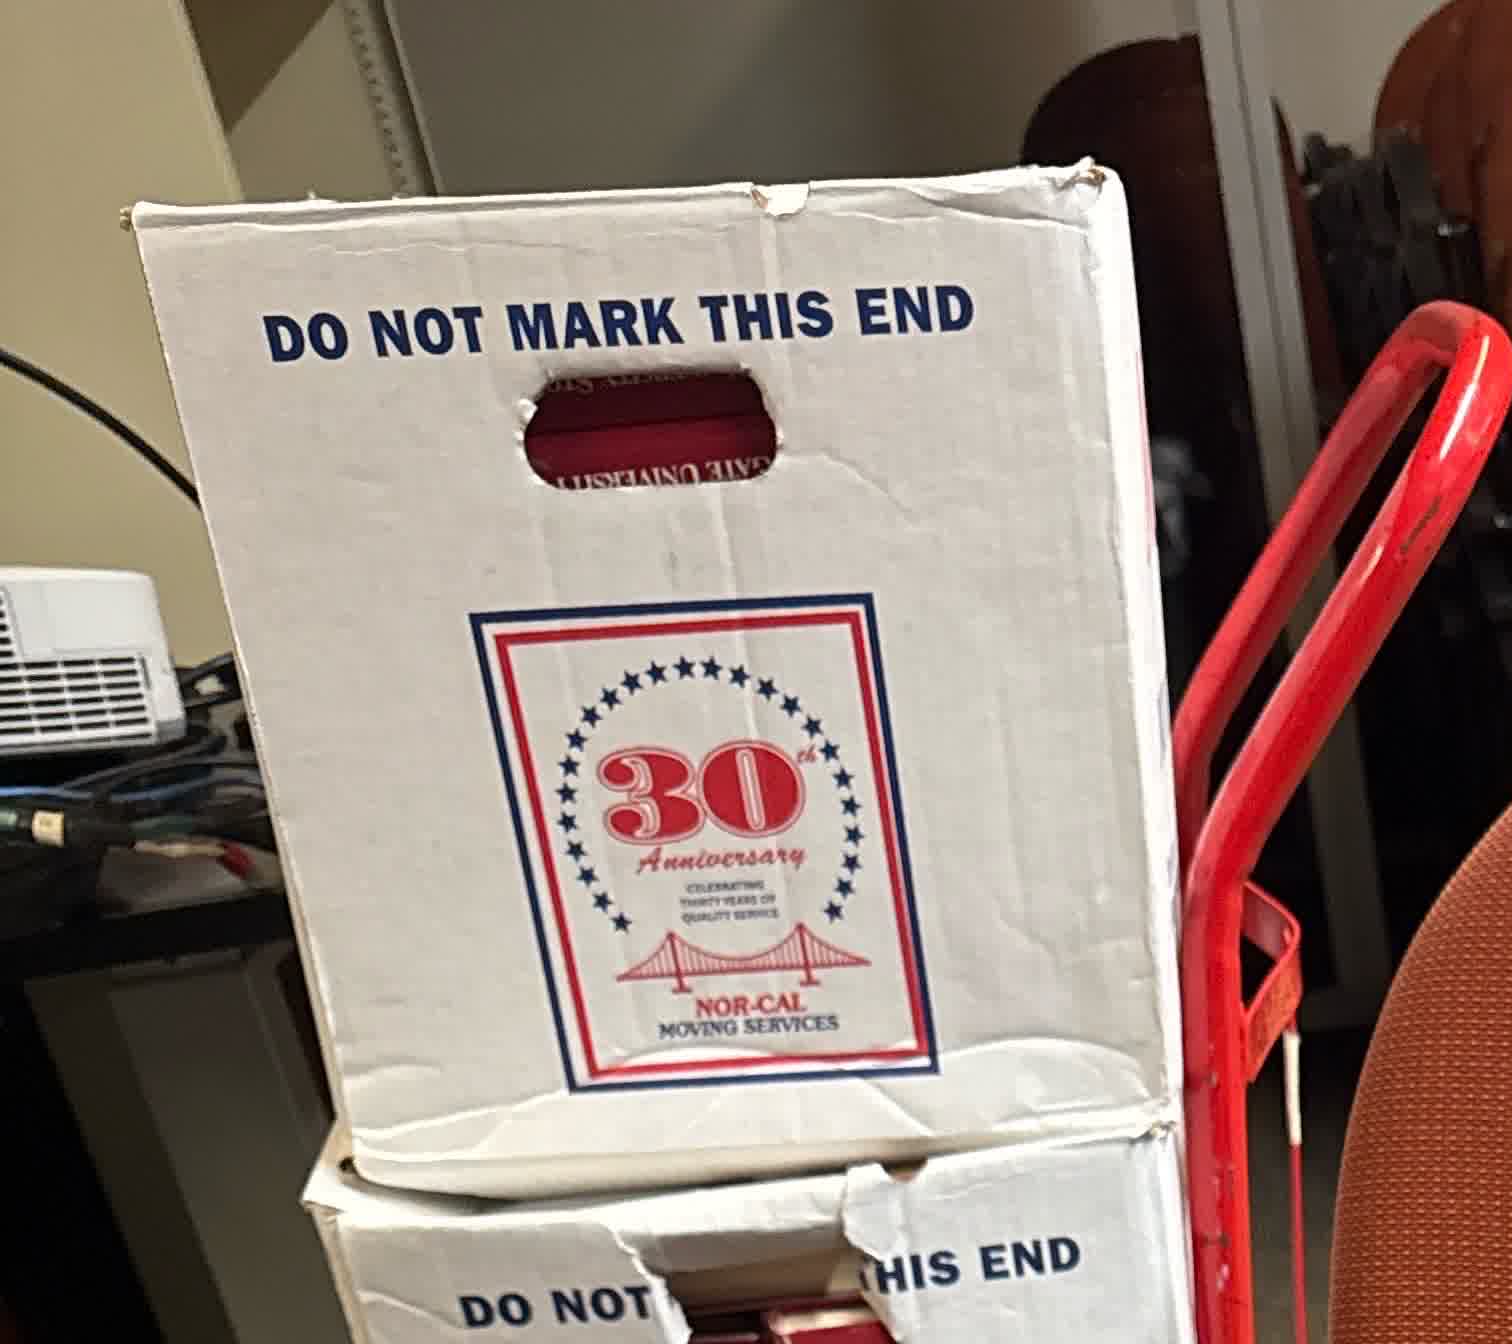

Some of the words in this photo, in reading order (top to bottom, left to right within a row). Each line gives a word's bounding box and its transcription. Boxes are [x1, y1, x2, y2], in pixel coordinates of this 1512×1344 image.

[262, 312, 348, 362] DO
[368, 306, 483, 357] NOT
[505, 297, 685, 351] MARK
[697, 290, 834, 342] THIS
[855, 285, 974, 336] END
[636, 846, 806, 875] Anniversary
[696, 992, 807, 1017] NOR-CAL
[658, 1020, 737, 1039] MOVING
[744, 1015, 839, 1033] SERVICES
[979, 1237, 1081, 1281] END
[459, 1291, 532, 1328] DO
[551, 1286, 651, 1323] NOT
